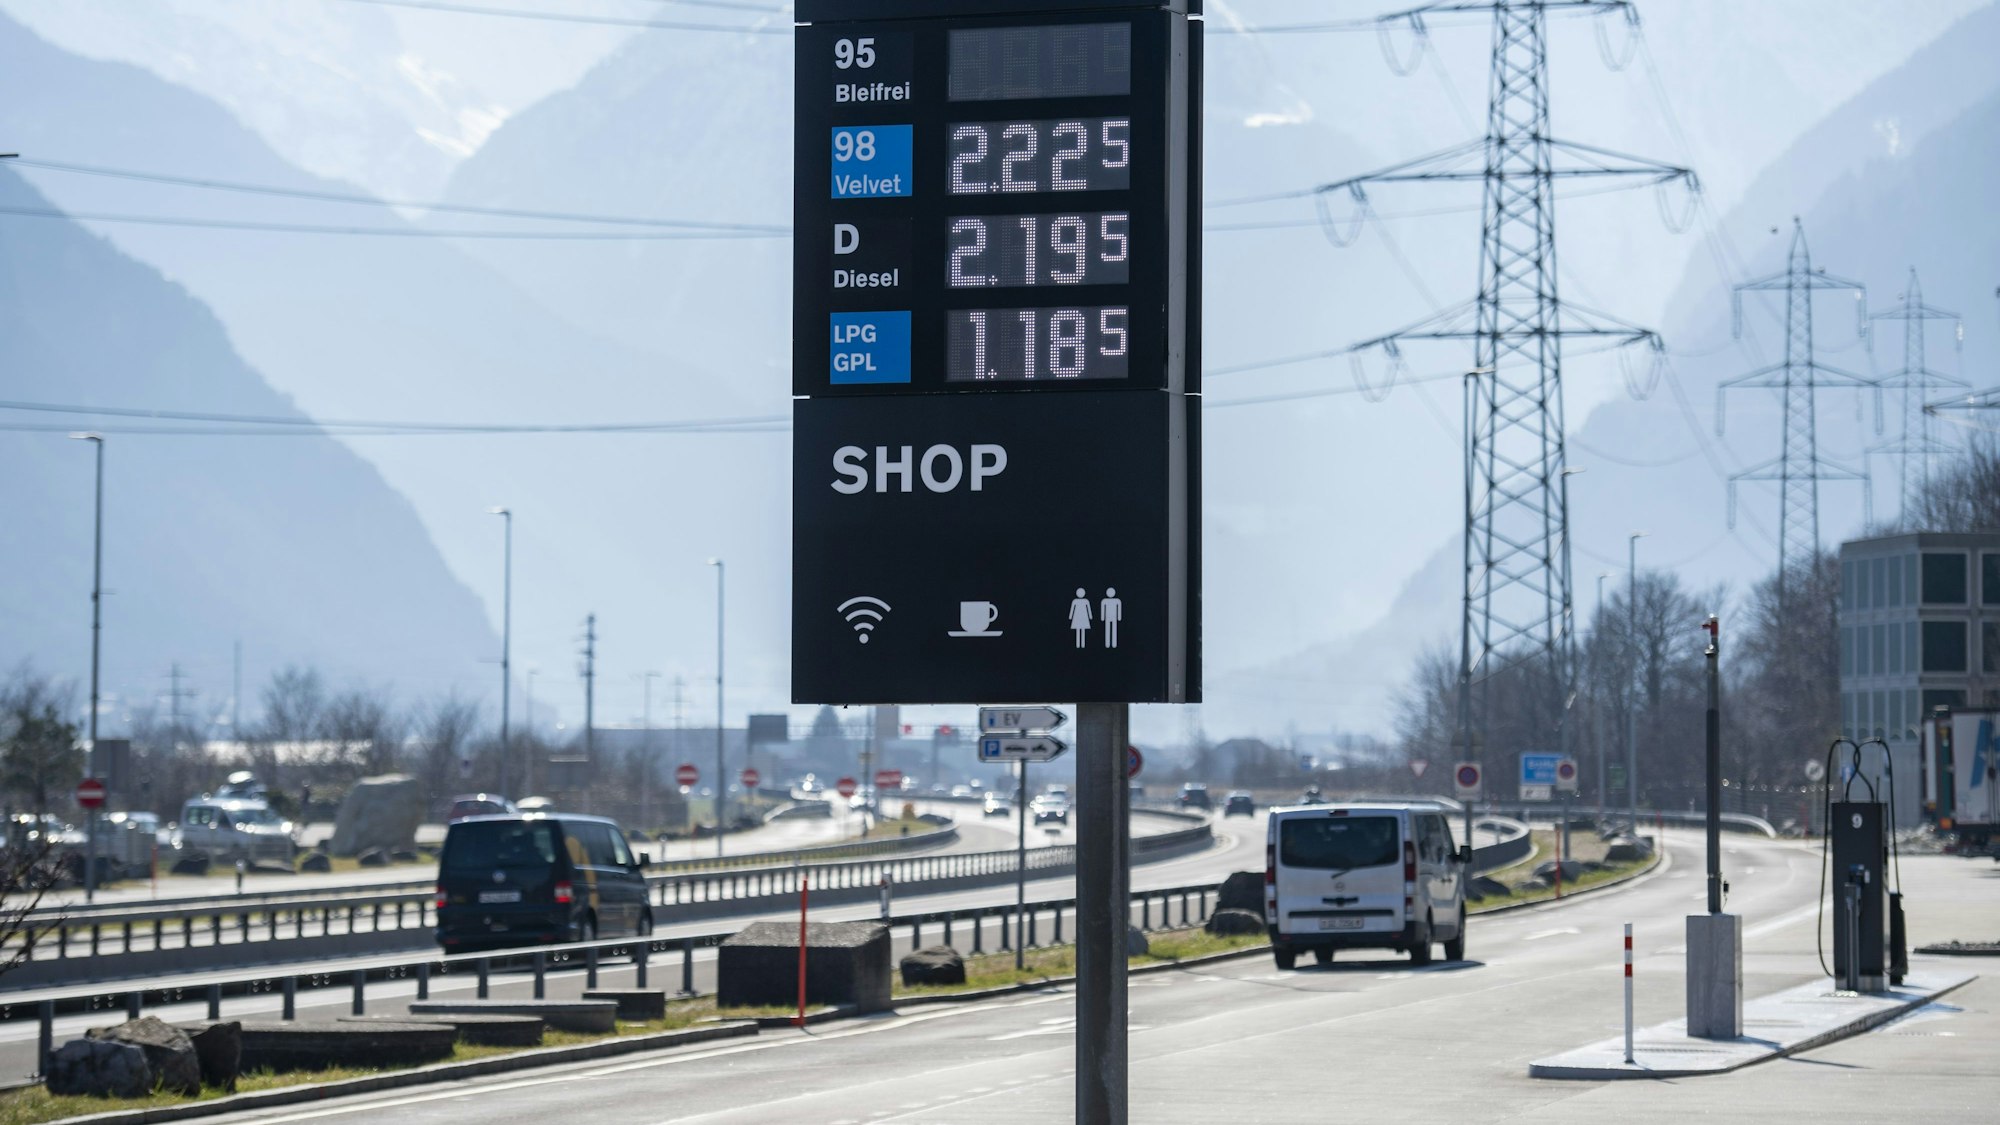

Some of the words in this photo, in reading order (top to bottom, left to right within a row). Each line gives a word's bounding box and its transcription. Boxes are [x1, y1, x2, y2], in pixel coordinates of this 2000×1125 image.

[835, 37, 876, 69] 95
[835, 82, 910, 102] Bleifrei
[835, 131, 876, 162] 98
[836, 175, 901, 194] Velvet
[834, 224, 860, 255] D
[834, 269, 899, 288] Diesel
[834, 325, 876, 343] LPG
[834, 353, 876, 371] GPL
[830, 443, 1008, 494] SHOP
[1004, 713, 1021, 726] EV
[1852, 813, 1863, 829] 9
